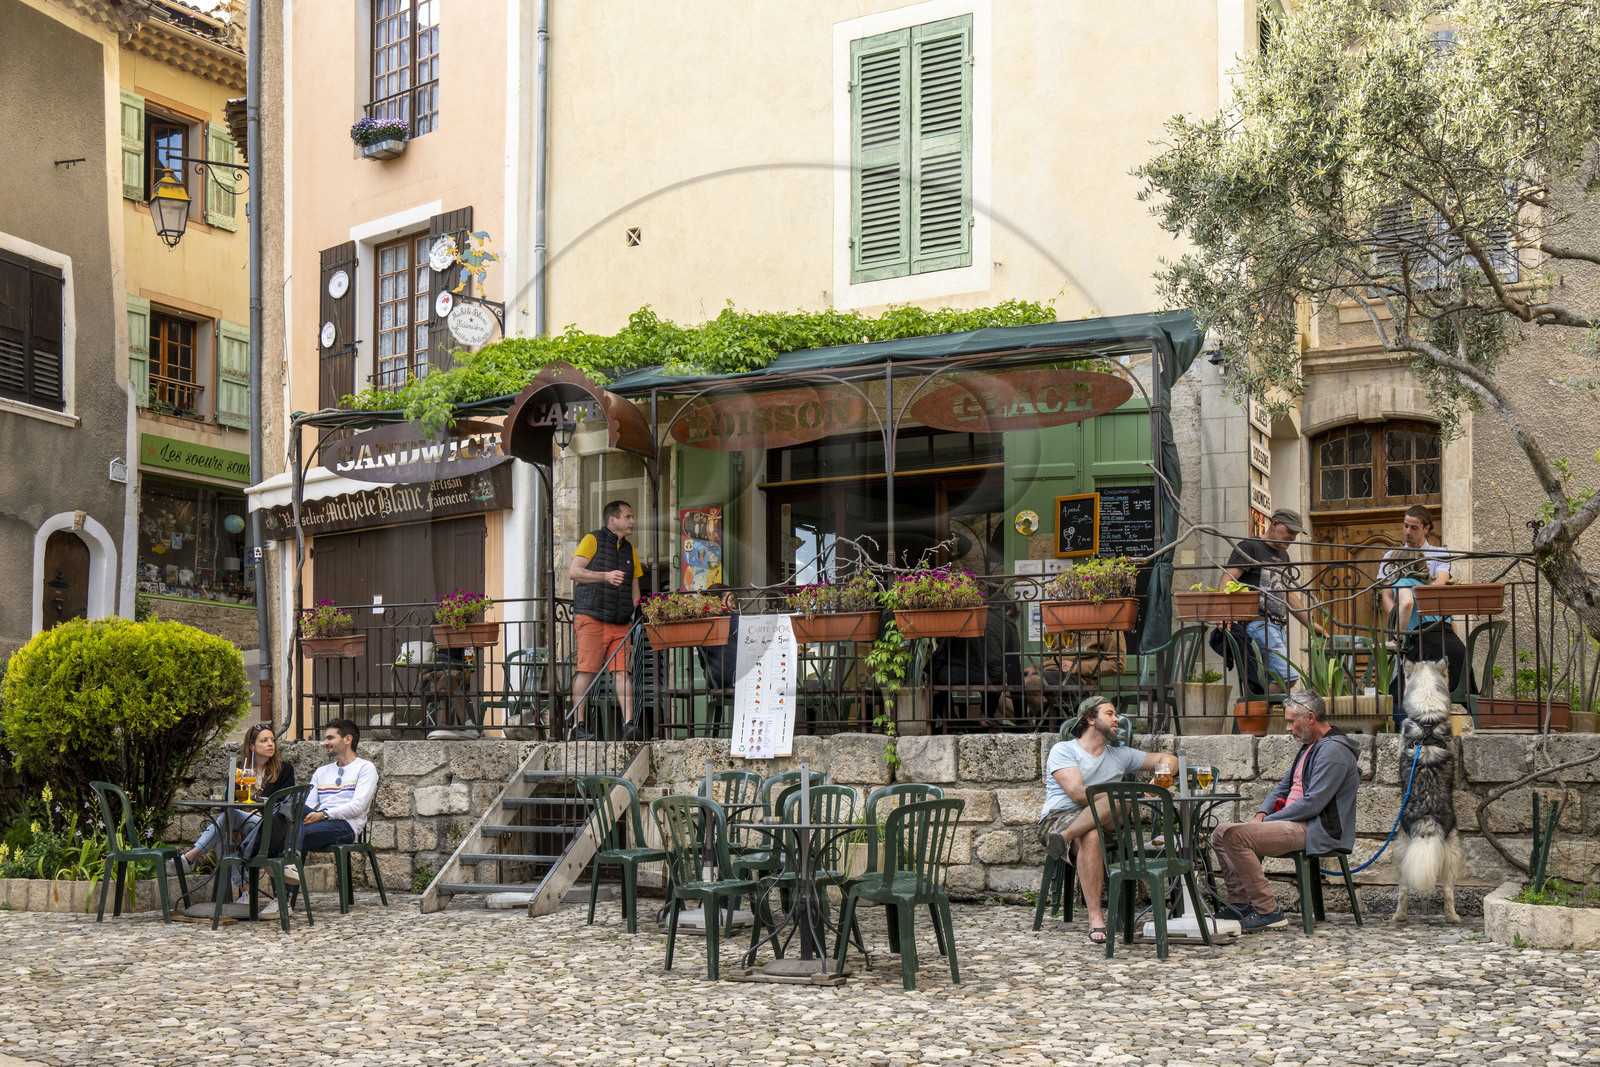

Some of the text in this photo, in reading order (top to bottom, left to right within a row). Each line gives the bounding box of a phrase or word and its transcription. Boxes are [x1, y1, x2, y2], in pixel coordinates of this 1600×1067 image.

[953, 382, 1093, 422] GLACE
[686, 400, 851, 443] BOISSON
[160, 443, 182, 462] Les
[185, 453, 224, 471] soeurs
[336, 432, 504, 472] SANDWICH
[1253, 445, 1269, 470] BOISSONS
[429, 478, 463, 491] Artisan
[375, 486, 425, 518] Blanc
[747, 625, 771, 635] CARTE
